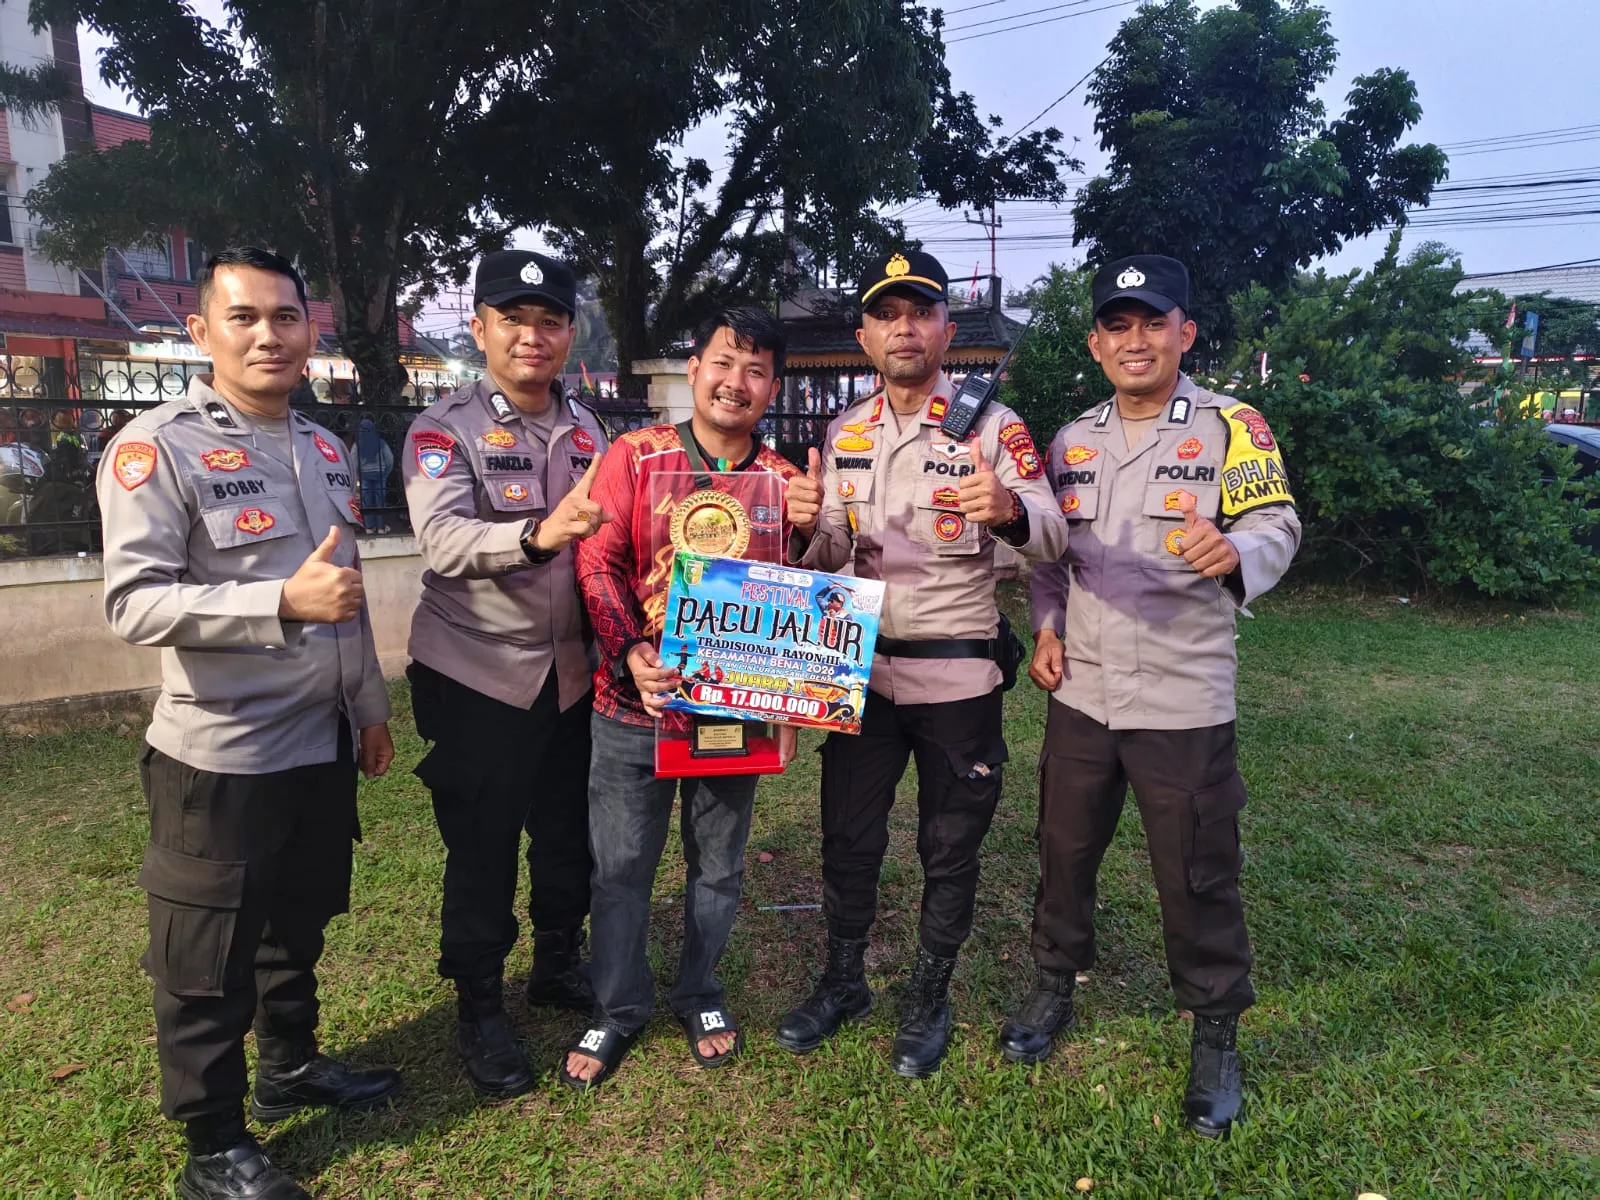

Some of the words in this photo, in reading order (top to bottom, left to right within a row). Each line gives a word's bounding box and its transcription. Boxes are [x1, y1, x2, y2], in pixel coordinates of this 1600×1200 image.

[923, 460, 976, 478] POLRI
[1154, 465, 1215, 482] POLRI
[212, 480, 267, 500] BOBBY
[741, 581, 813, 609] FESTIVAL
[673, 597, 763, 640] PACU
[766, 608, 865, 667] JALUR
[697, 636, 779, 657] TRADISIONAL
[782, 648, 825, 663] RAYON
[826, 654, 841, 666] III
[697, 648, 767, 666] KECAMATAN
[769, 658, 803, 671] BENAI
[806, 664, 836, 676] 2026
[725, 669, 789, 692] JUARA
[700, 685, 726, 704] Rp.
[730, 689, 820, 717] 17.000.000
[700, 1010, 726, 1032] DC
[578, 1029, 606, 1052] DC
